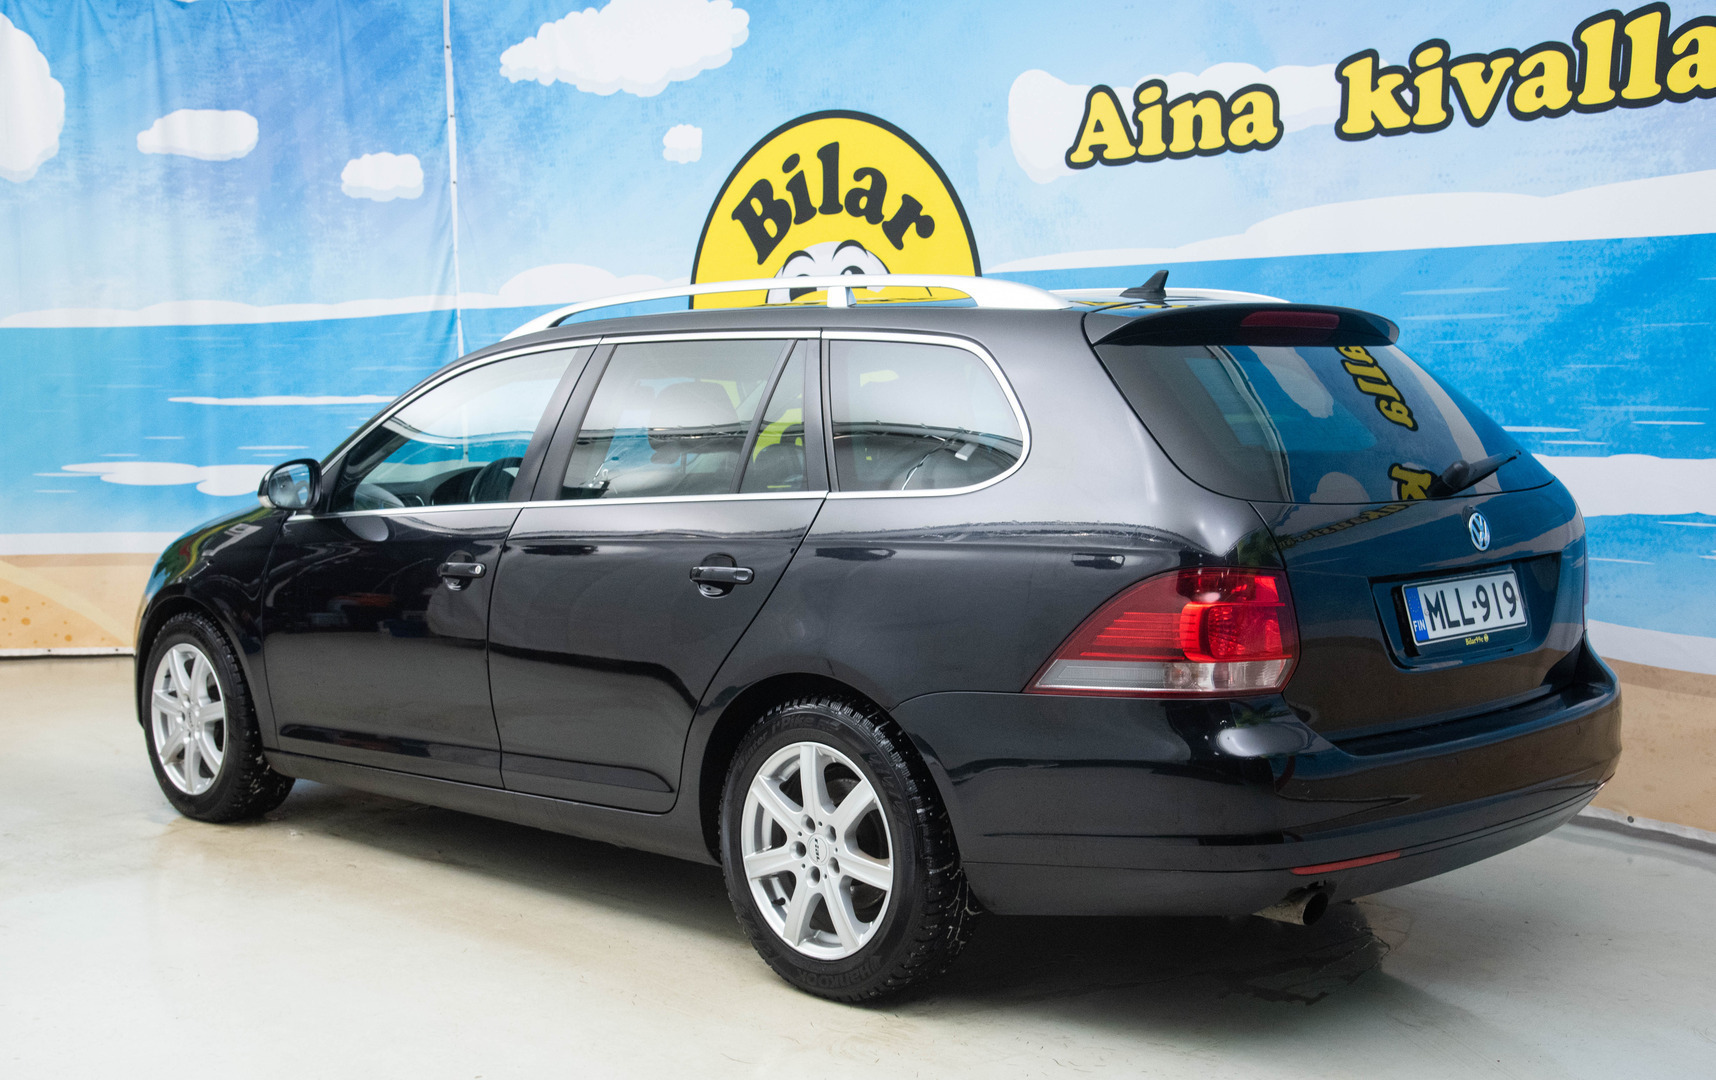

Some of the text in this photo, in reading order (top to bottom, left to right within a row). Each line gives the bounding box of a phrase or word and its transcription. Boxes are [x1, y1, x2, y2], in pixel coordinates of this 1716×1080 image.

[1065, 2, 1716, 169] Aina kivalla
[731, 141, 936, 266] Bilar
[1412, 619, 1427, 633] FIN
[1423, 580, 1517, 632] MLL-919
